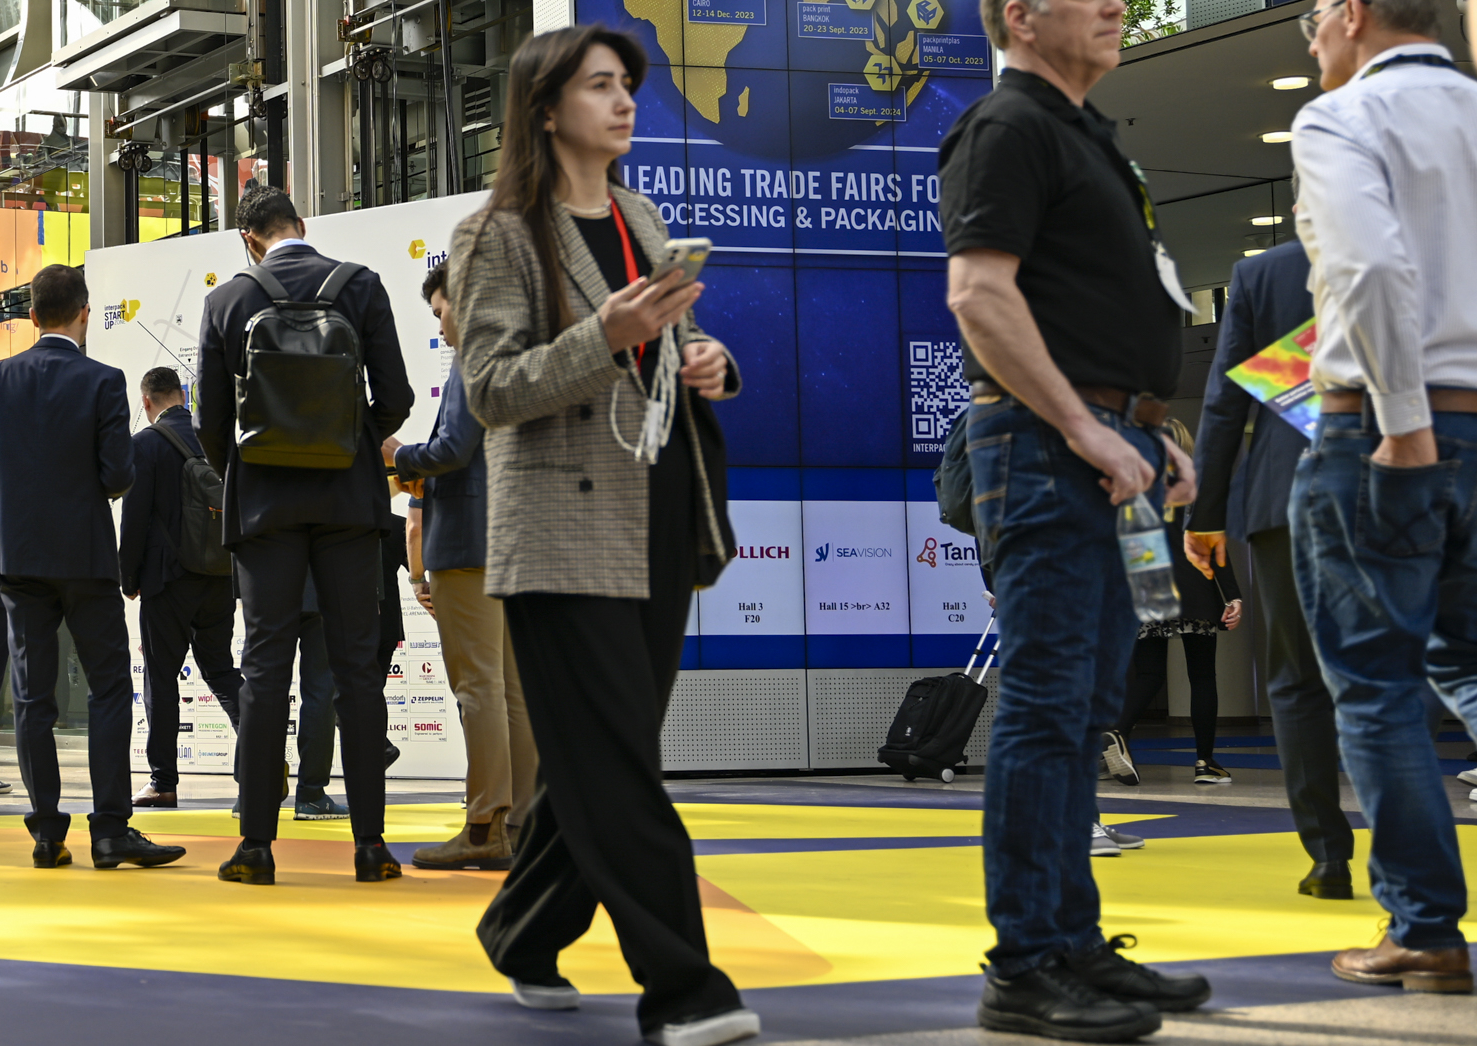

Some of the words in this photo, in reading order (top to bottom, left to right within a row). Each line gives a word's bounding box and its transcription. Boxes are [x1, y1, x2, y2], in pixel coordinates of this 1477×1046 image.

[692, 0, 711, 7] CAIRO
[803, 5, 816, 13] pack
[818, 6, 831, 14] print
[717, 10, 733, 18] Dec.
[735, 11, 755, 19] 2023
[803, 14, 830, 22] BANGKOK
[829, 26, 847, 34] Sept.
[849, 27, 868, 35] 2023
[923, 37, 960, 45] packprintplas
[948, 56, 963, 64] Oct.
[965, 57, 984, 65] 2023
[834, 86, 859, 95] indopack
[834, 96, 857, 104] JAKARTA
[835, 106, 858, 114] 04-07
[860, 107, 878, 116] Sept.
[623, 164, 732, 197] LEADING
[740, 168, 822, 200] TRADE
[830, 171, 902, 203] FAIRS
[912, 174, 941, 204] FO
[659, 203, 785, 228] OCESSING
[795, 207, 813, 229] &
[820, 208, 944, 233] PACKAGIN
[104, 303, 126, 312] interpack
[104, 311, 126, 321] START
[105, 320, 114, 330] UP
[732, 546, 790, 559] LLICH
[836, 548, 892, 558] SEAVISION
[940, 542, 976, 560] Tan
[738, 602, 756, 611] Hall
[757, 602, 764, 611] 3
[819, 602, 837, 611] Hall
[839, 602, 849, 611] 15
[874, 602, 890, 611] A32
[942, 602, 960, 611] Hall
[961, 602, 967, 611] 3
[744, 614, 760, 624] F20
[948, 614, 965, 623] C20
